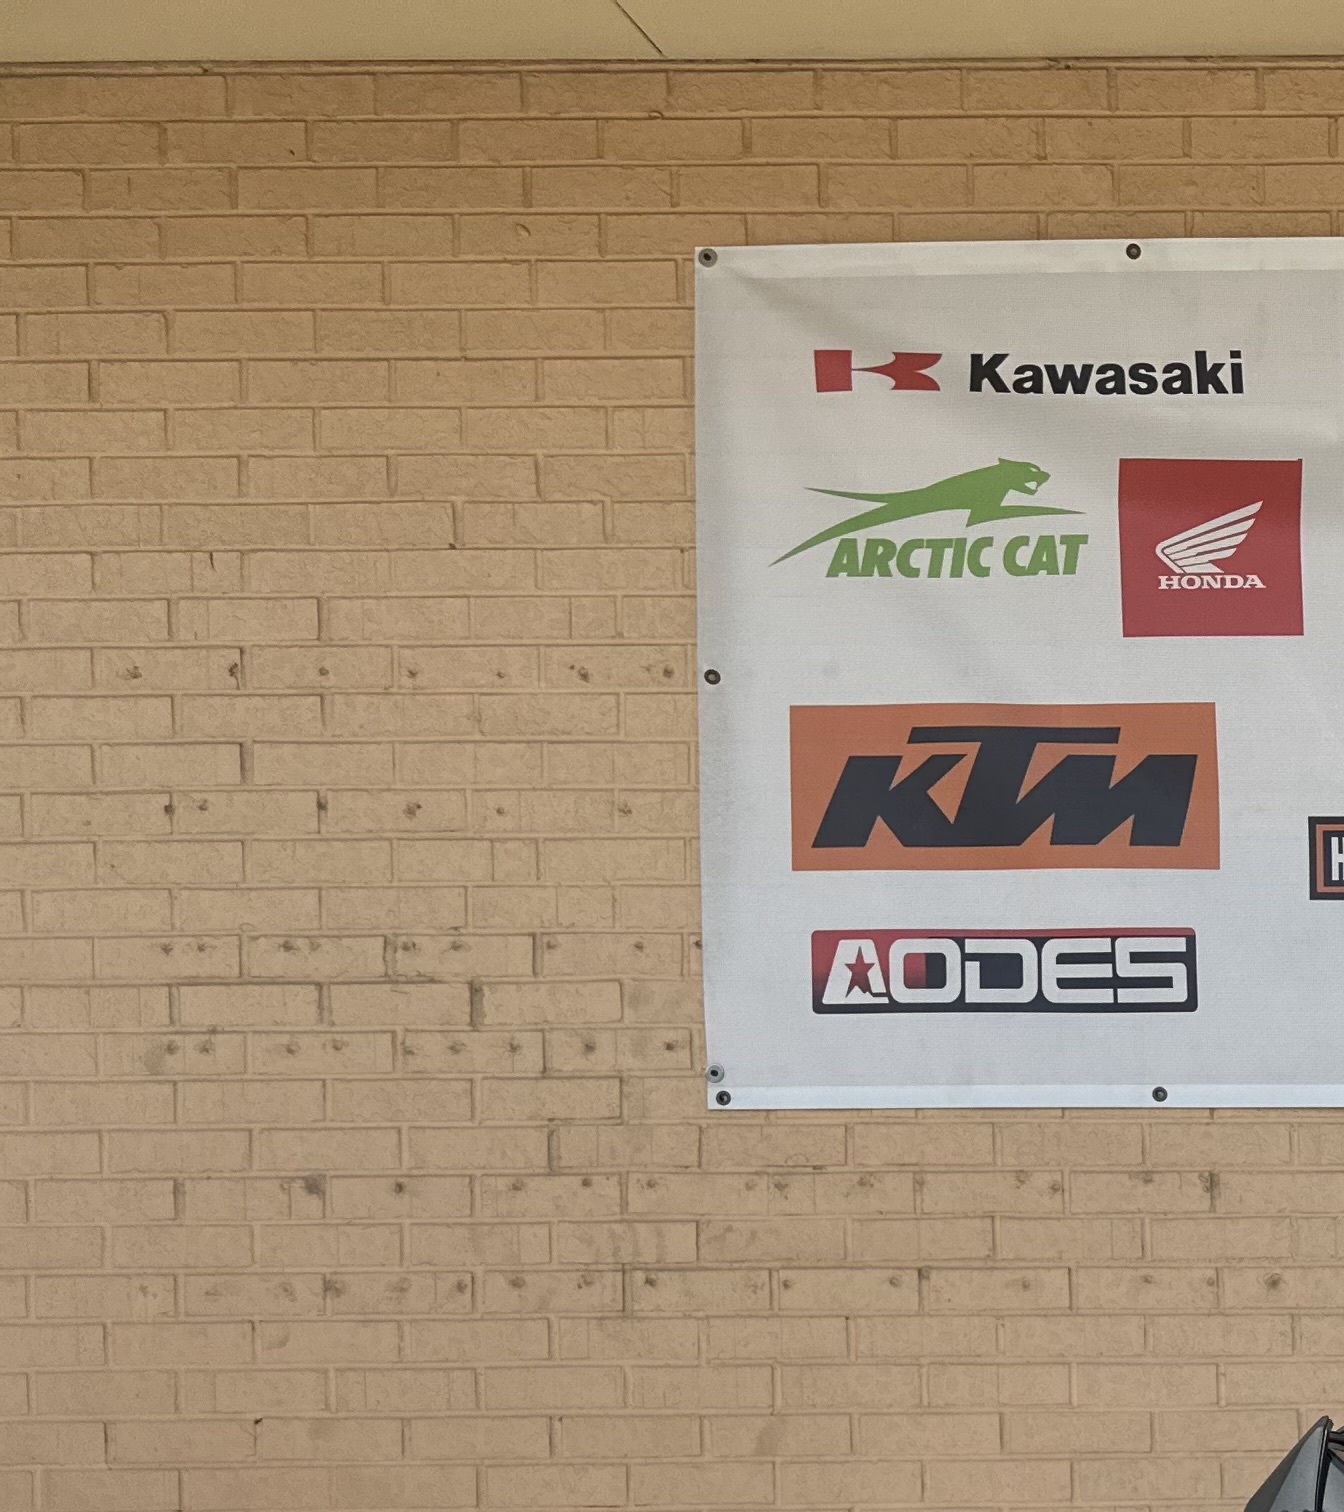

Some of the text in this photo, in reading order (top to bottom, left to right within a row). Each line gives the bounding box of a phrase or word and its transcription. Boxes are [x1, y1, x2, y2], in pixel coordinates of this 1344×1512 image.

[968, 349, 1245, 396] Kawasaki
[826, 533, 1089, 579] ARCTIC CAT
[1157, 574, 1267, 591] HONDA
[811, 726, 1199, 848] KTM
[820, 936, 1187, 1006] AODES
